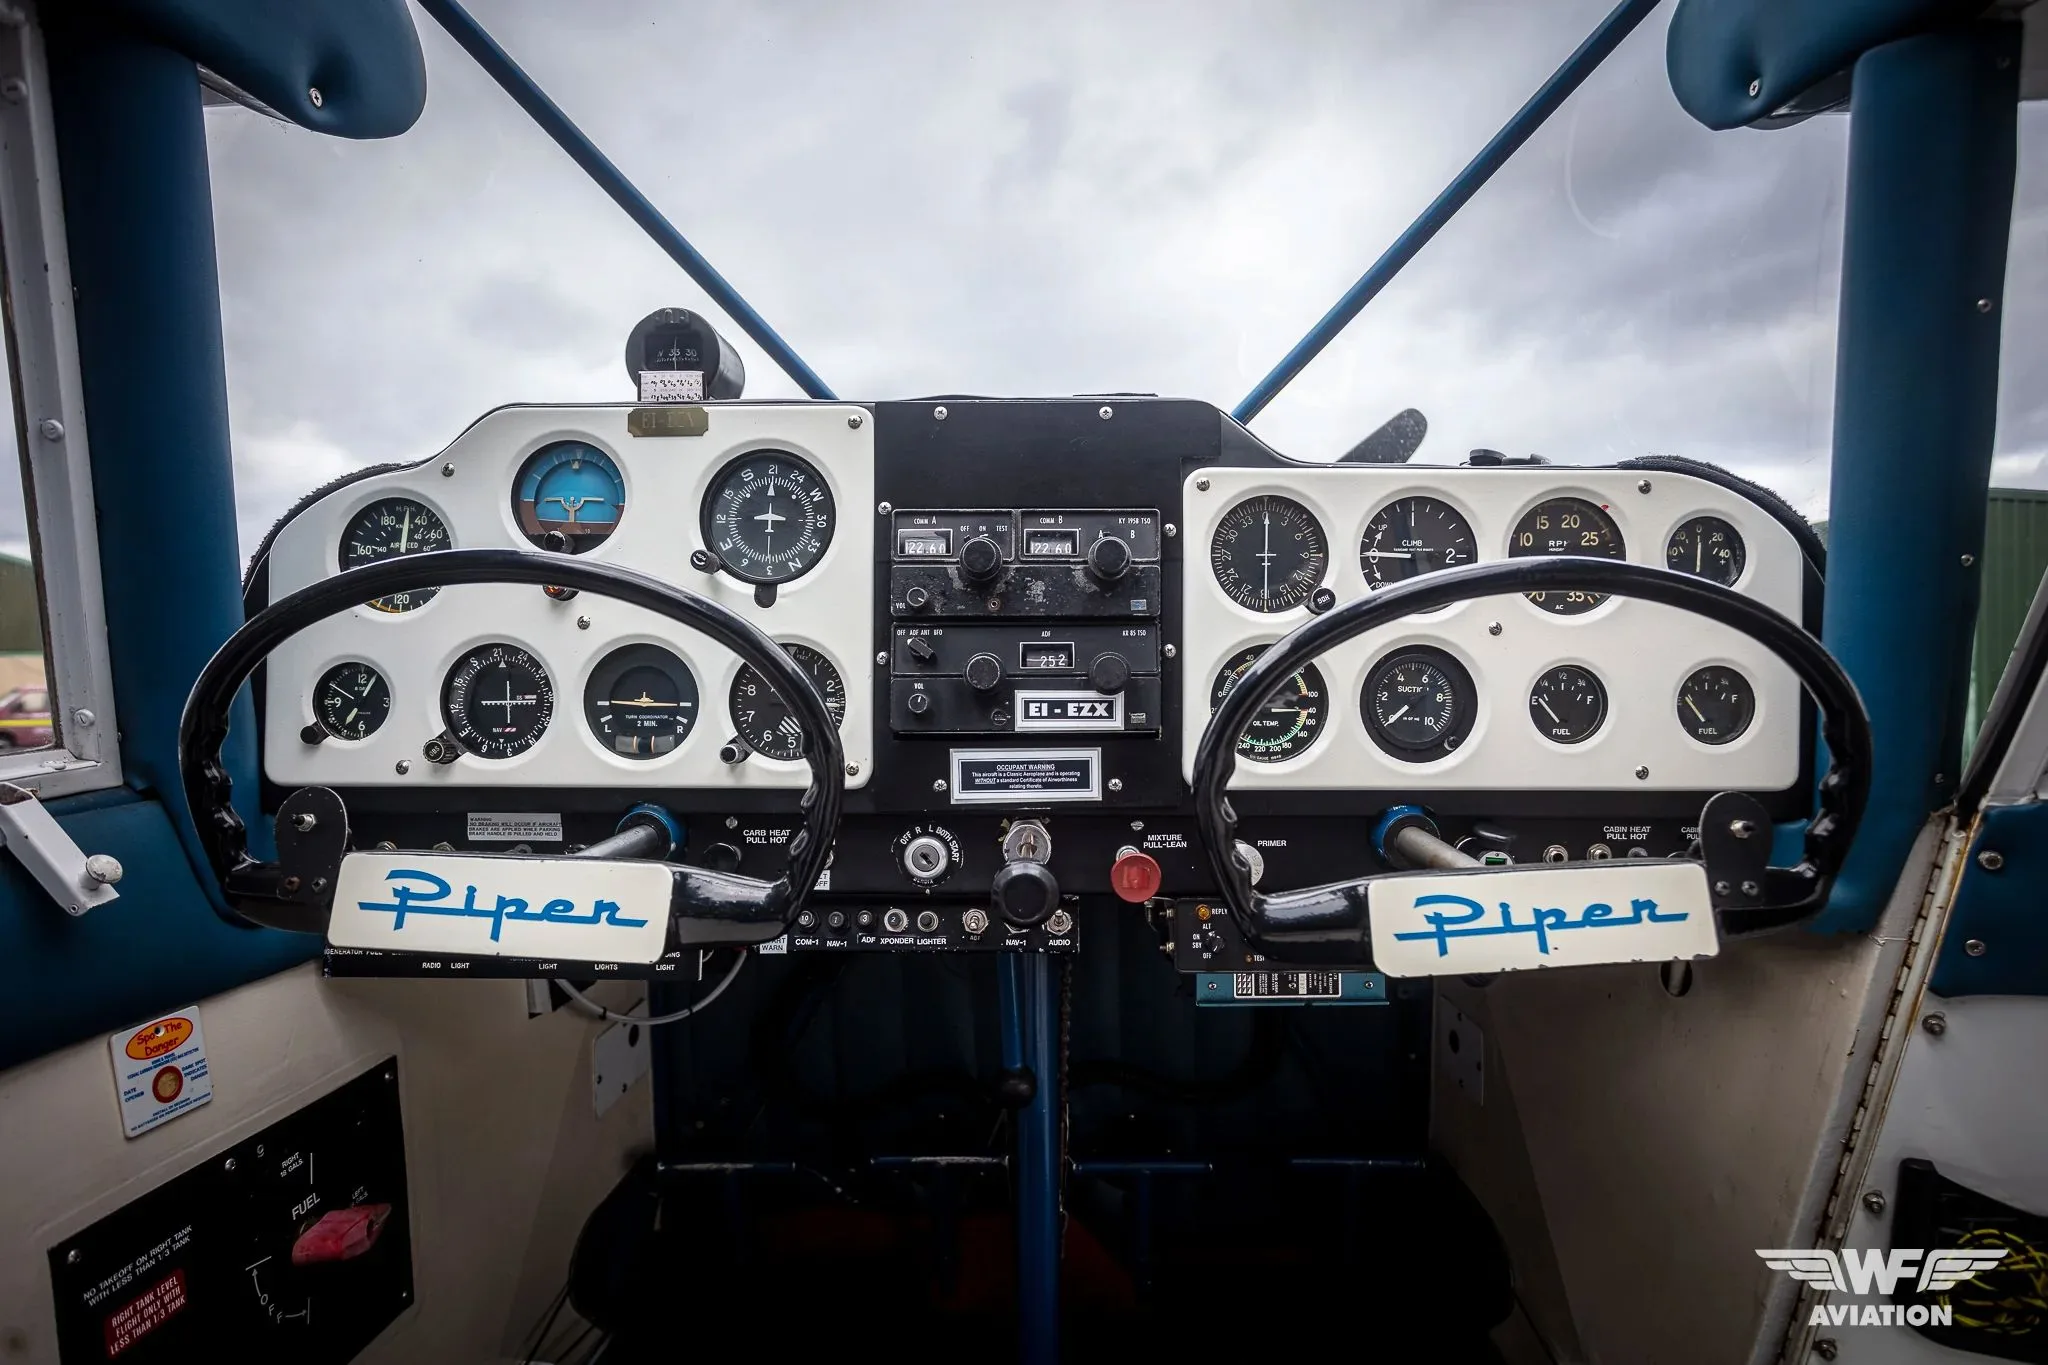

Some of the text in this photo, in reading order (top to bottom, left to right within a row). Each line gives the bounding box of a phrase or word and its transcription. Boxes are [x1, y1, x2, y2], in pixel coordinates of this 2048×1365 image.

[741, 468, 754, 481] S
[769, 465, 777, 474] 21
[790, 470, 805, 483] 24
[810, 488, 824, 502] W
[381, 516, 395, 526] 180
[415, 516, 427, 525] 40
[931, 516, 936, 524] A
[1240, 516, 1253, 528] 33
[1537, 516, 1549, 529] 15
[1561, 515, 1580, 528] 20
[1226, 530, 1238, 543] 30
[1520, 533, 1533, 546] 10
[1581, 532, 1599, 546] 25
[720, 538, 733, 551] E
[1222, 549, 1232, 561] 27
[1446, 548, 1455, 563] 2
[788, 558, 802, 572] N
[394, 595, 409, 604] 120
[1040, 654, 1065, 667] 252
[1532, 696, 1538, 705] E
[1587, 696, 1594, 704] F
[1732, 694, 1738, 703] F
[746, 711, 755, 722] 7
[1424, 717, 1434, 725] 10
[459, 728, 469, 737] E
[605, 724, 611, 733] L
[763, 730, 772, 741] 6
[788, 737, 796, 748] 5
[429, 746, 440, 757] OBS
[900, 824, 959, 862] OFF R L BOTH START
[358, 869, 648, 942] Piper
[1393, 894, 1689, 958] Piper
[137, 1021, 182, 1046] Spo The
[145, 1036, 179, 1056] Danger
[195, 1058, 205, 1068] SPOT
[124, 1088, 136, 1096] DATE
[281, 1152, 300, 1168] RIGHT
[288, 1159, 303, 1173] GALS
[291, 1192, 321, 1220] FUEL
[83, 1225, 192, 1300] NO TAKEOFF ON RIGHT TANK
[89, 1235, 191, 1306] WITH LESS THAN 1/3 TANK
[112, 1276, 178, 1327] RIGHT TANK LEVEL
[116, 1286, 181, 1338] FLIGHT ONLY WITH
[110, 1295, 185, 1355] LESS THAN 1/3 TANK
